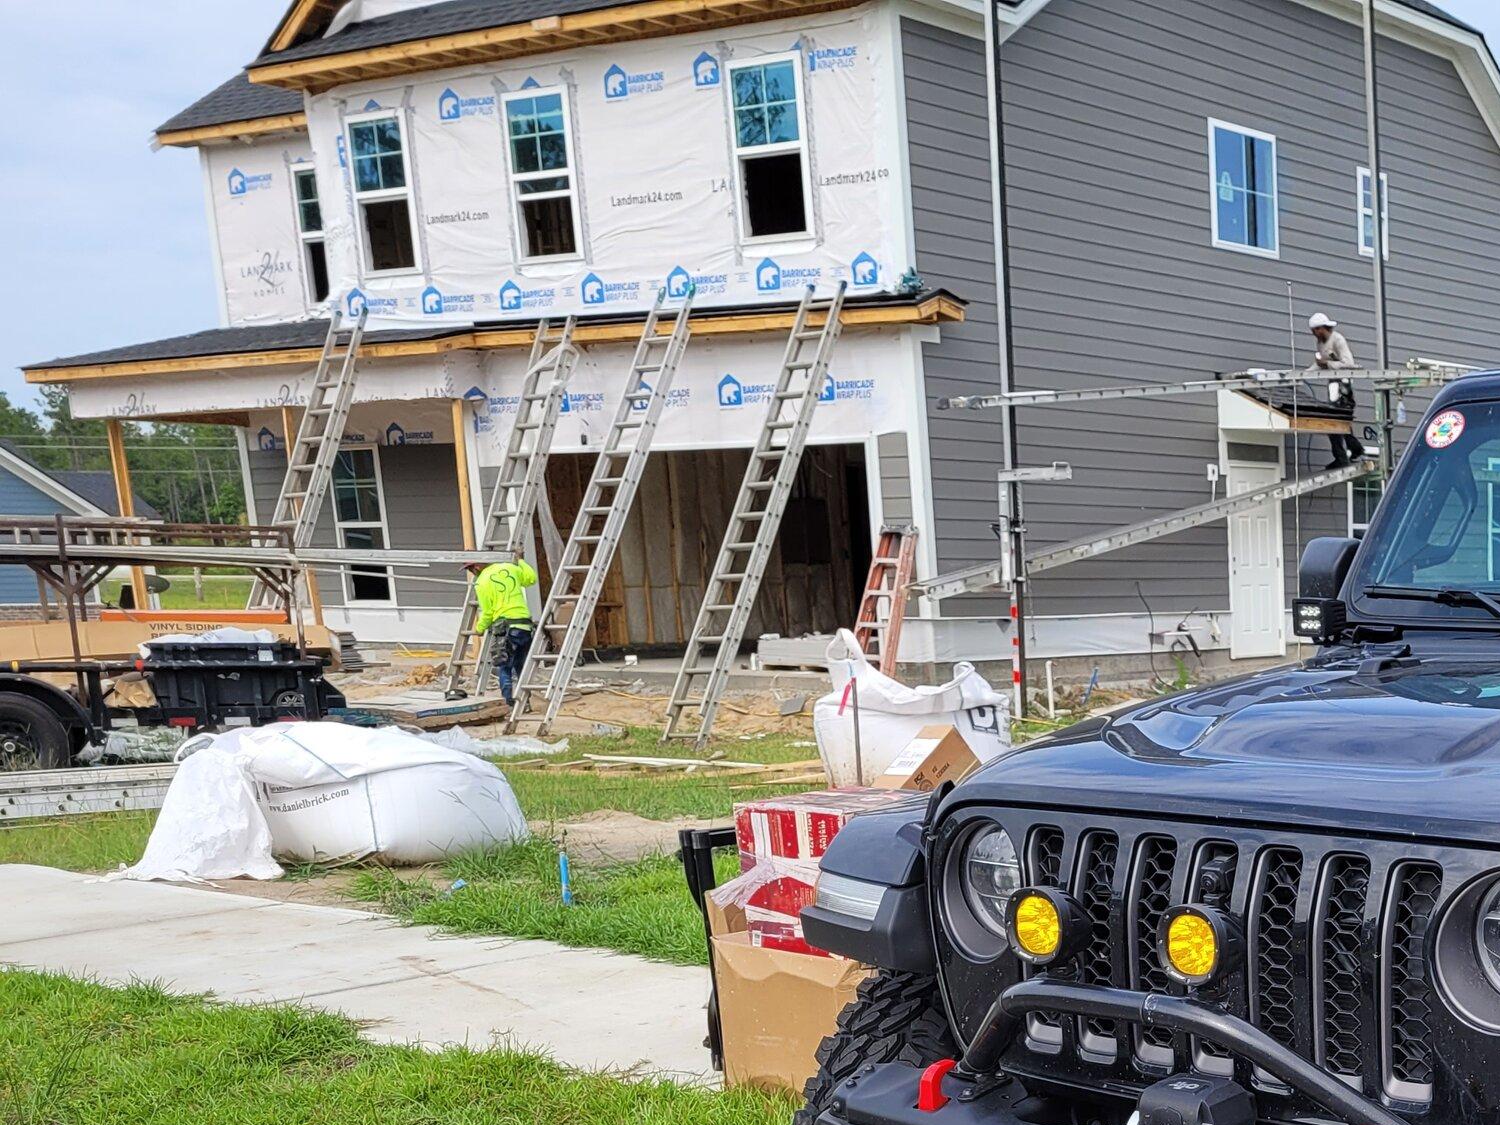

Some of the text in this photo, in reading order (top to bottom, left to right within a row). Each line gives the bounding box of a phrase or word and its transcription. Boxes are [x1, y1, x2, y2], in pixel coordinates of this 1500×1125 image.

[627, 71, 664, 84] BARRICADE
[460, 96, 495, 107] BARRICADE
[611, 191, 683, 207] Landmark24.com
[426, 211, 489, 225] Landmark24.com
[781, 267, 821, 278] BARRICADE
[604, 281, 640, 291] BARRICADE
[522, 288, 555, 298] BARRICADE
[836, 379, 875, 389] BARRICADE
[149, 623, 182, 631] VINYL
